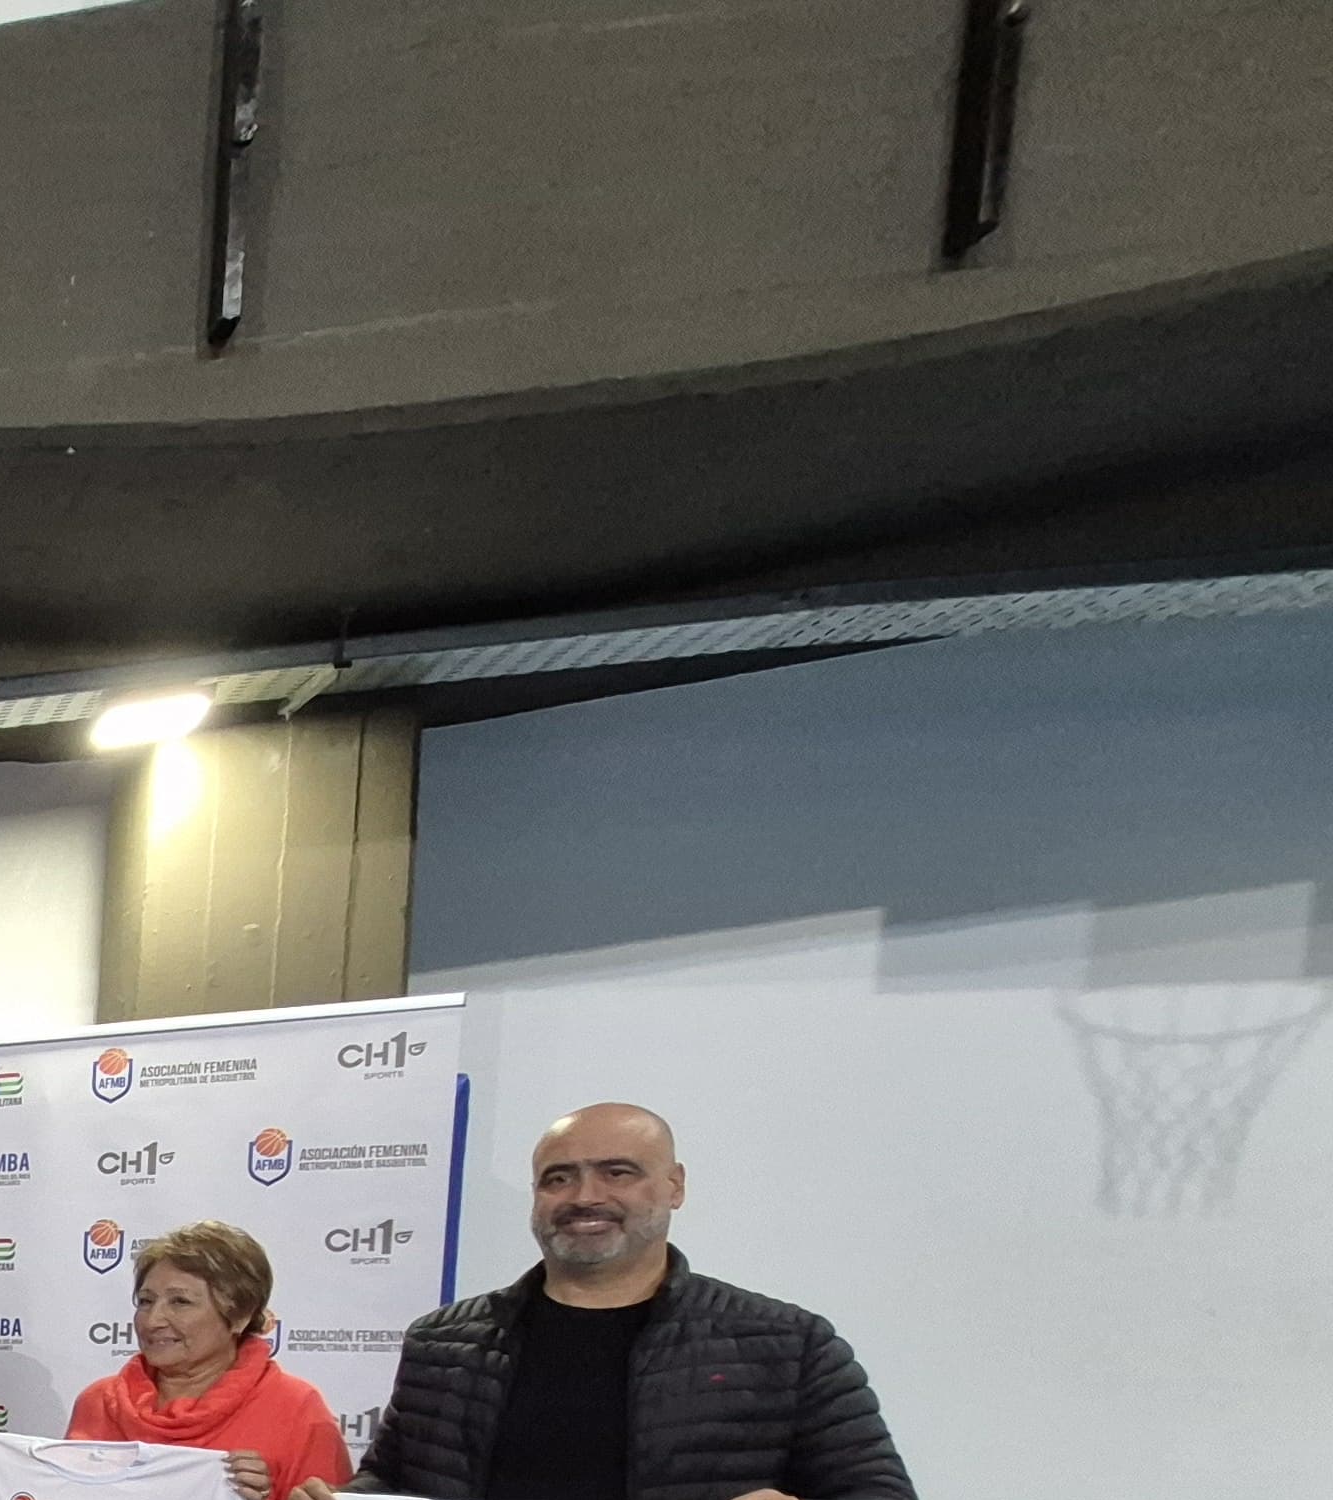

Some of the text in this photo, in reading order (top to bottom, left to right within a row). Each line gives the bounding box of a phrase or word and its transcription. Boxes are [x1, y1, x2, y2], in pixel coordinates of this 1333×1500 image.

[140, 1059, 257, 1078] ASOCIACIÓN FEMENINA
[364, 1072, 404, 1080] SPORTS
[99, 1077, 126, 1089] AFMB
[300, 1144, 428, 1160] ASOCIACIÓN FEMENINA
[255, 1158, 284, 1171] AFMB
[121, 1178, 155, 1186] SPORTS
[90, 1248, 117, 1260] AFMB
[350, 1257, 390, 1265] SPORTS
[288, 1328, 353, 1342] ASOCIACIÓN
